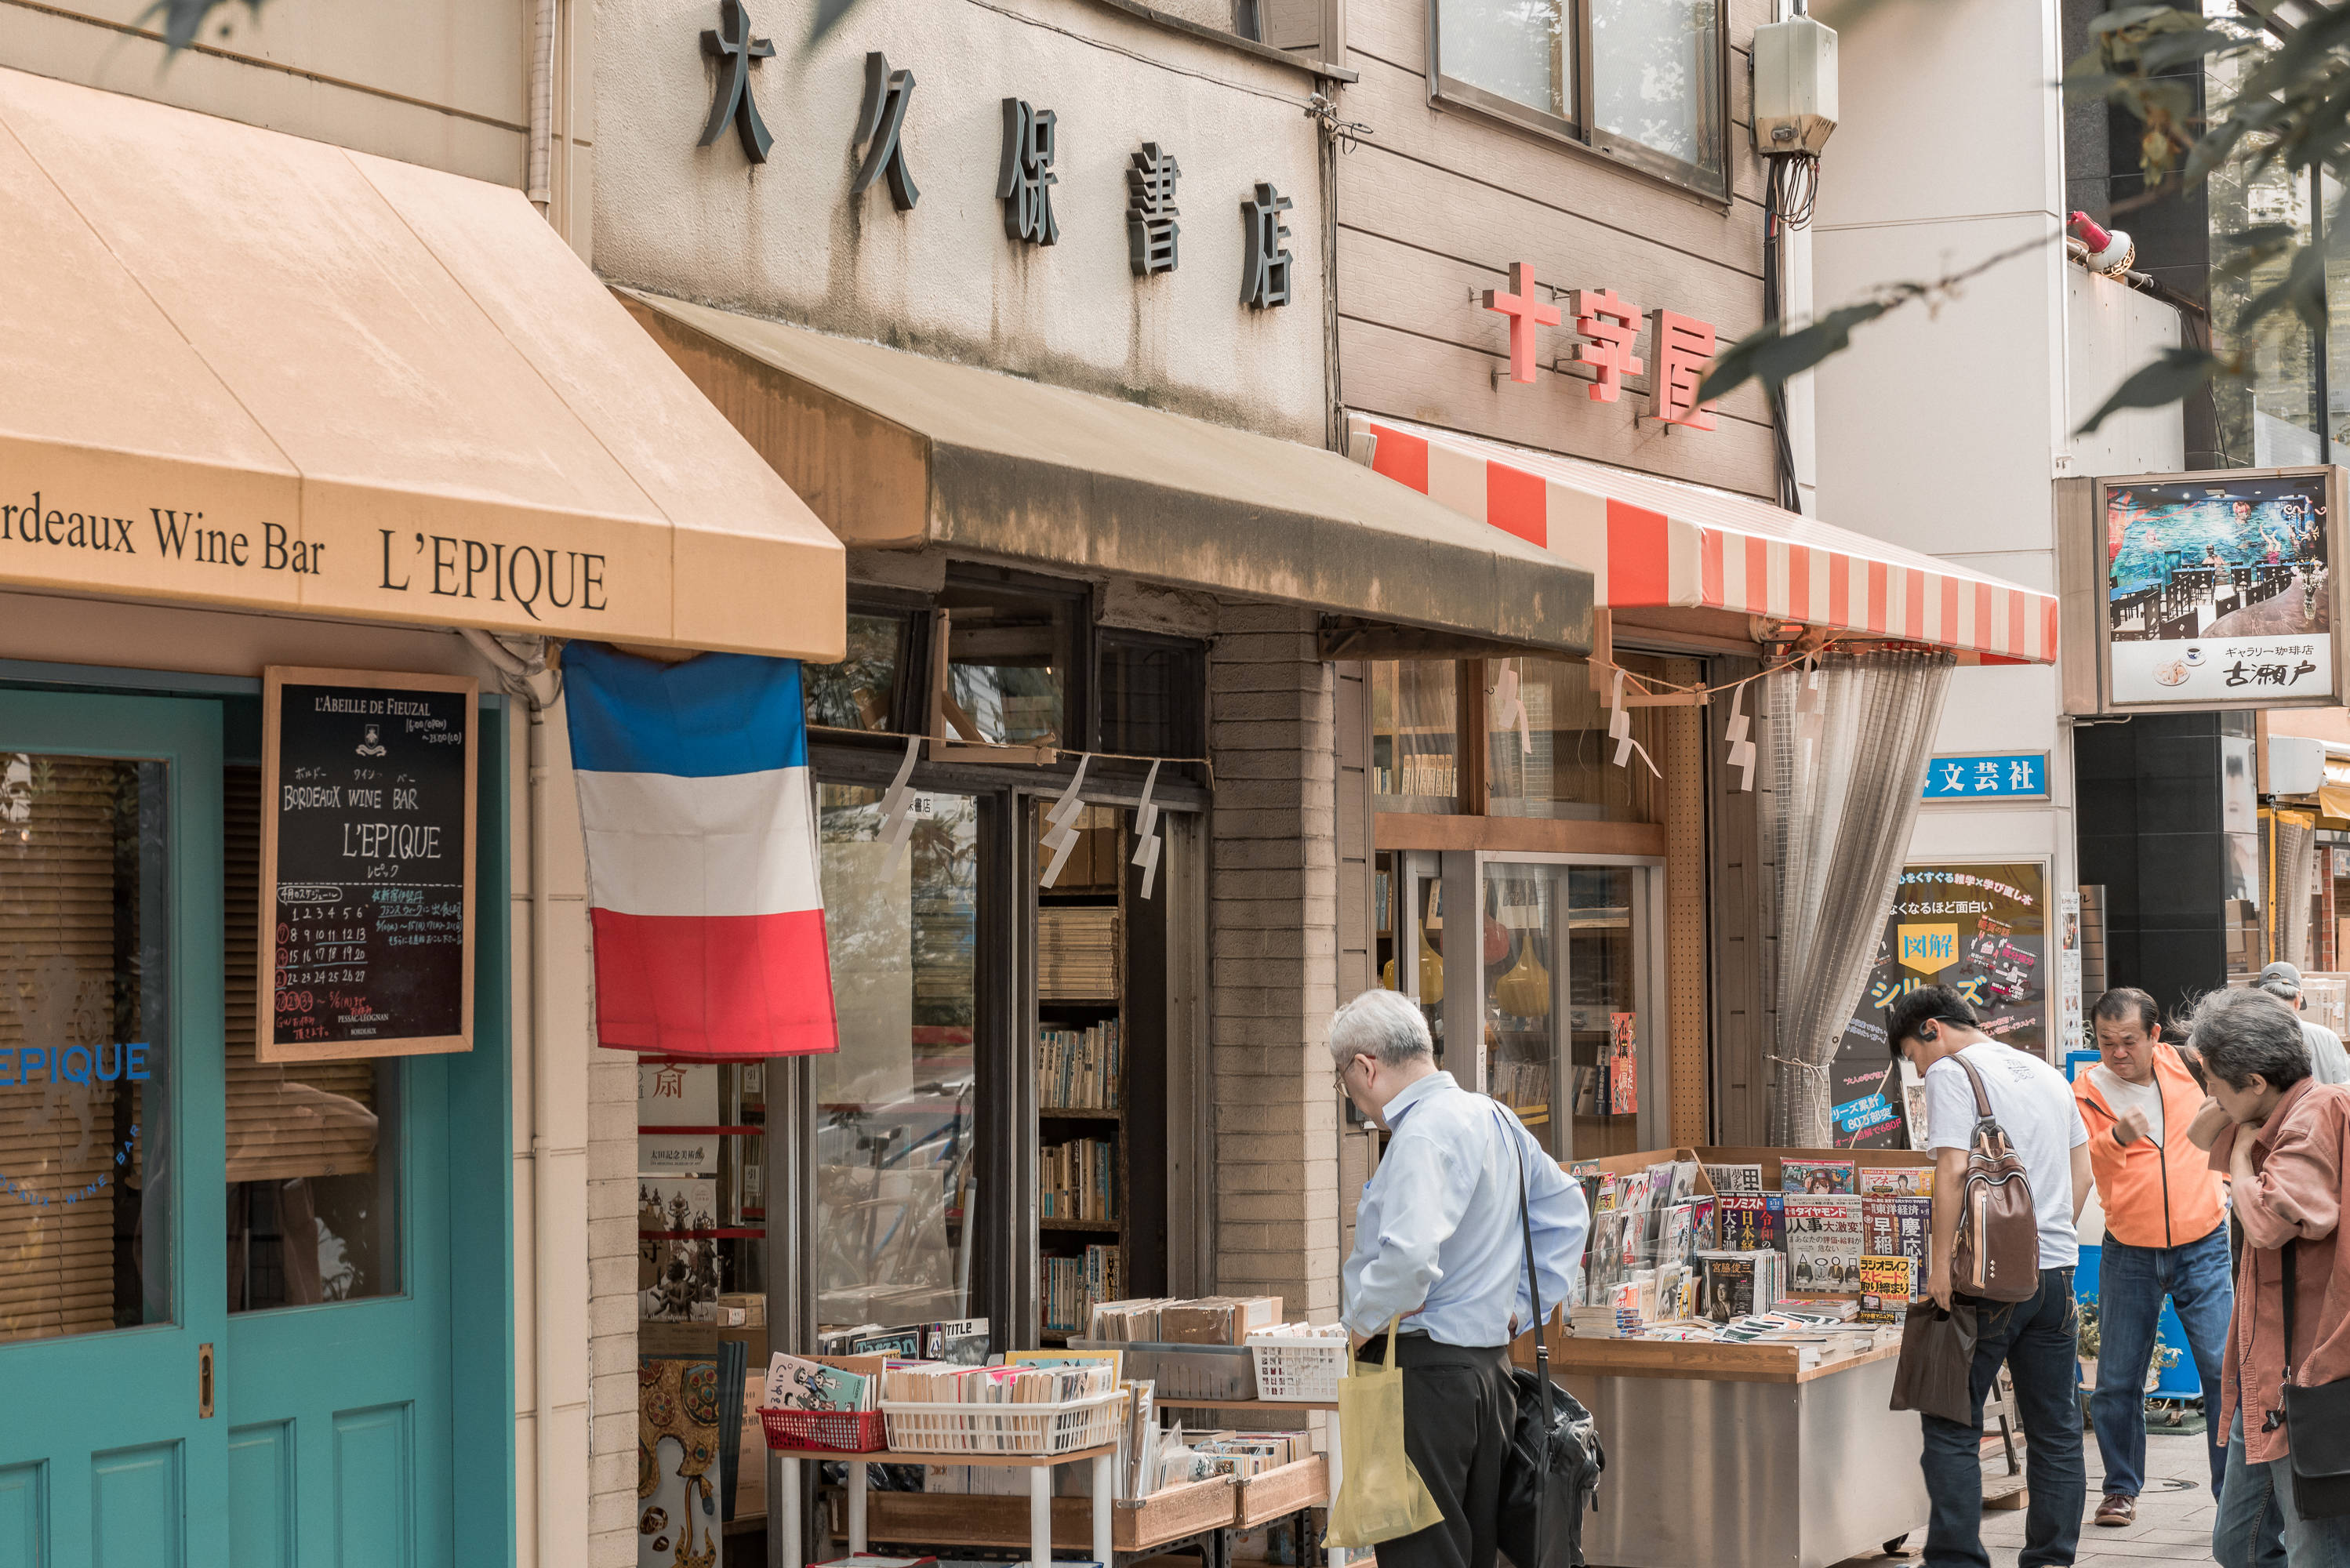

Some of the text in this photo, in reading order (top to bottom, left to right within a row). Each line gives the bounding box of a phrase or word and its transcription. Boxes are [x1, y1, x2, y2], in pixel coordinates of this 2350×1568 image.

[696, 0, 1292, 310] 大久保書店
[1483, 262, 1717, 430] 十字屋
[149, 507, 249, 567] Wine
[261, 521, 325, 575] Bar
[379, 528, 608, 621] L'EPIQUE
[2225, 645, 2314, 658] ギャラリー珈琲店
[2223, 660, 2316, 687] 古瀬戸
[369, 701, 384, 714] DE
[387, 698, 430, 716] FIEUZAL
[1925, 760, 2035, 792] 文芸社
[283, 785, 419, 811] BORDEAUX WINE BAR
[343, 823, 441, 859] L'EPIQUE
[368, 863, 399, 879] レピック
[315, 930, 324, 940] 10
[328, 930, 336, 941] 11
[343, 928, 353, 940] 12
[356, 927, 366, 941] 13
[289, 949, 297, 963] 15
[303, 949, 311, 963] 16
[315, 947, 325, 960] 17
[328, 947, 336, 961] 18
[343, 946, 352, 960] 19
[354, 948, 365, 960] 20
[1904, 934, 1953, 960] 図解
[287, 973, 298, 985] 22
[301, 972, 311, 983] 23
[314, 971, 325, 984] 24
[328, 971, 339, 982] 25
[342, 969, 353, 982] 26
[355, 971, 365, 983] 27
[1871, 975, 1988, 1009] シリズ
[1832, 1097, 1879, 1120] リーズ累計
[1847, 1105, 1892, 1130] 80万部突
[116, 1124, 140, 1165] BAR
[65, 1174, 107, 1205] WINE
[1870, 1175, 1898, 1186] マネー
[1795, 1207, 1847, 1218] ダイヤモンド
[1876, 1203, 1919, 1215] 東洋経済
[1760, 1210, 1774, 1249] 令和の
[1712, 1261, 1751, 1273] 宮脇俊三
[1860, 1259, 1909, 1271] ラジオライフ
[1861, 1271, 1903, 1283] スピード
[1861, 1282, 1909, 1294] 取り締まり
[855, 1334, 917, 1355] Tarzan
